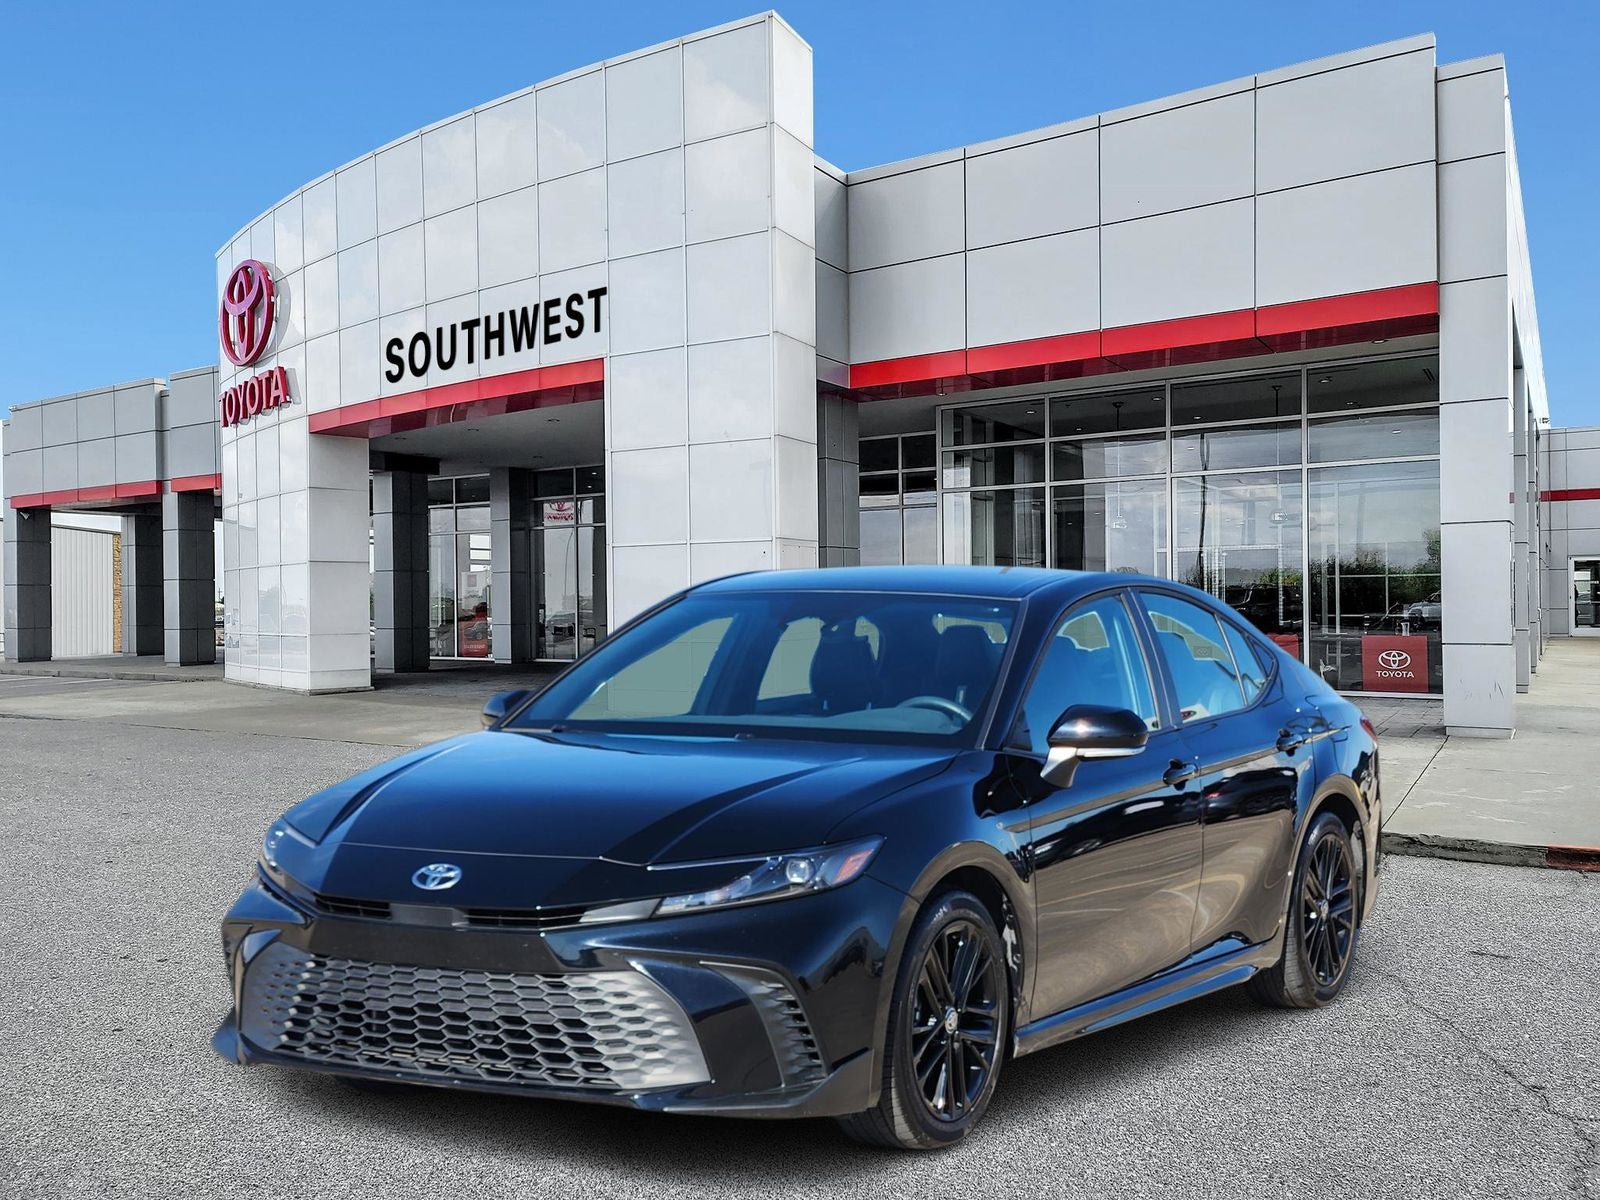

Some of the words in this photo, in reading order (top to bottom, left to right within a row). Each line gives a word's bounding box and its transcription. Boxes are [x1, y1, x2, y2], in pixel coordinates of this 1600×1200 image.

[385, 286, 608, 384] SOUTHWEST
[219, 366, 291, 428] TOYOTA
[1375, 670, 1415, 678] TOYOTA
